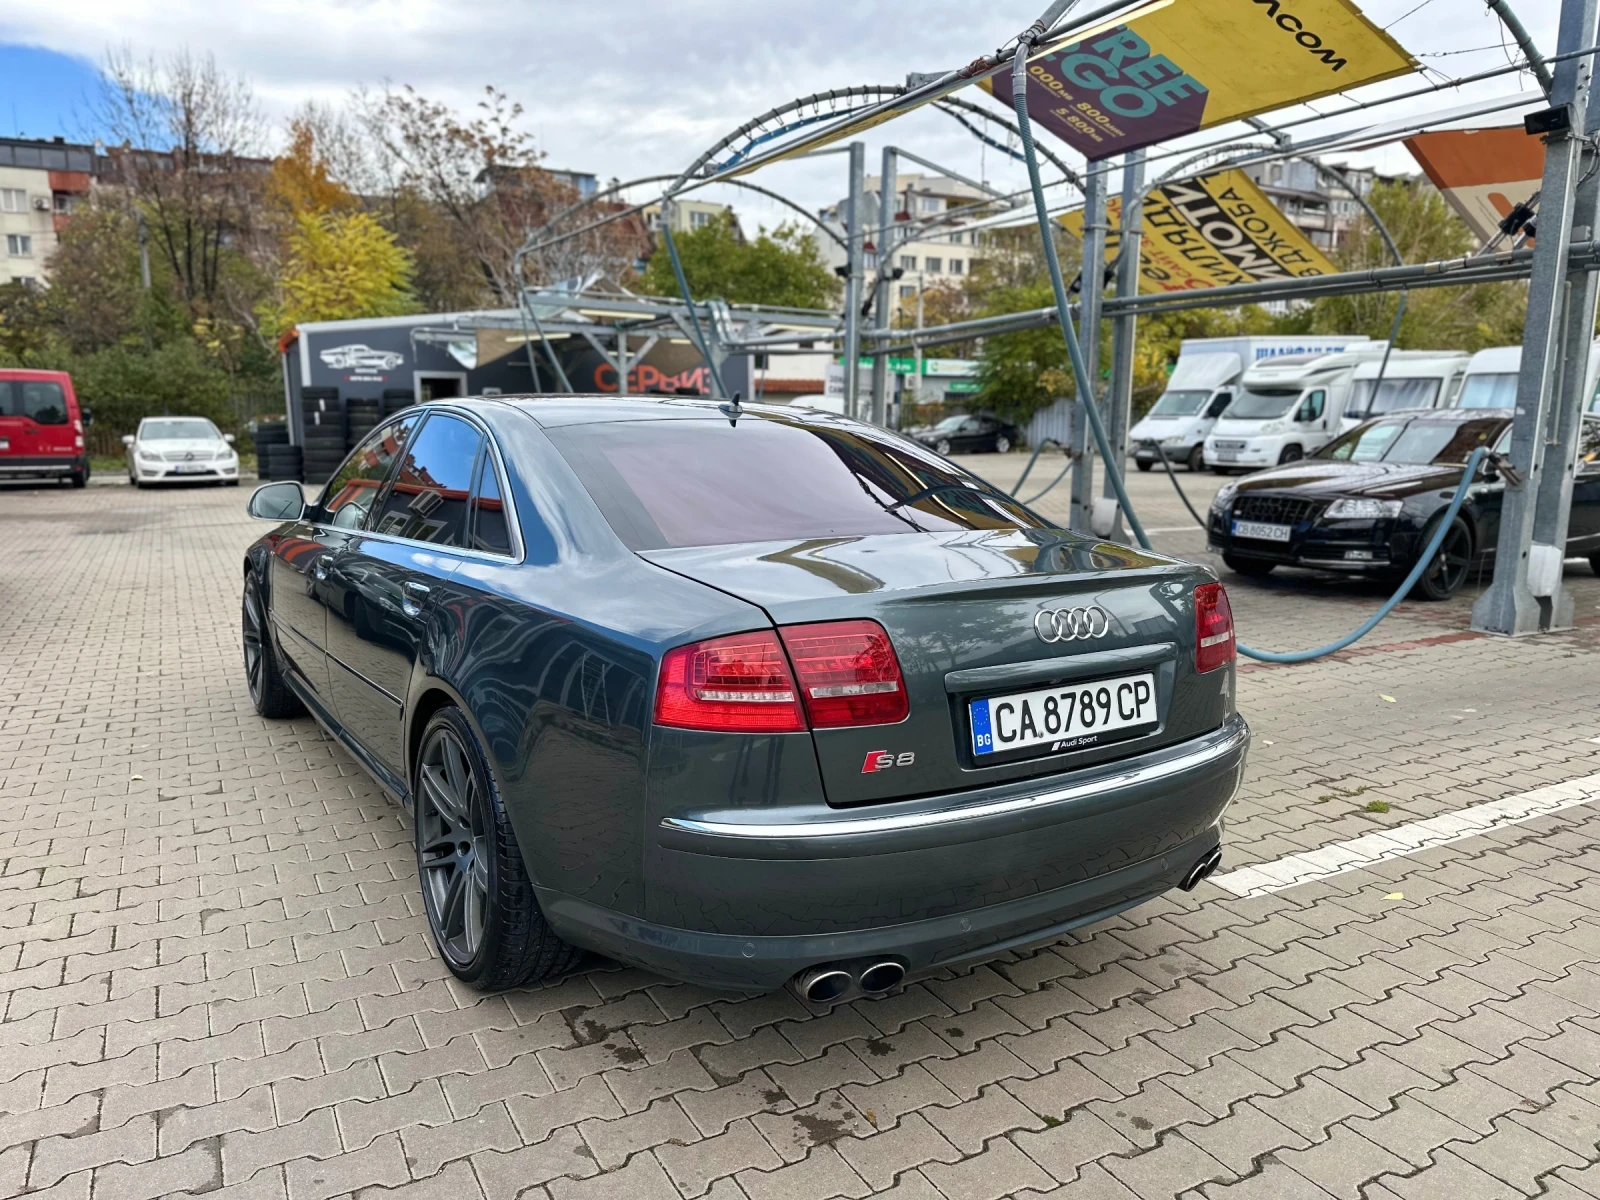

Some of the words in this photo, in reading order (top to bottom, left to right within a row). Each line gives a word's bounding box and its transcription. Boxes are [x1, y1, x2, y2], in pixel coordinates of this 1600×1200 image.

[1164, 176, 1290, 281] ИМОТИ
[1218, 186, 1313, 264] ДЖОБА
[995, 699, 1038, 743] CA
[1043, 687, 1112, 735] 8789
[1116, 680, 1150, 721] CP
[874, 751, 916, 770] S8
[976, 733, 992, 747] BG
[1060, 738, 1078, 749] Audi
[1078, 735, 1098, 748] Sport
